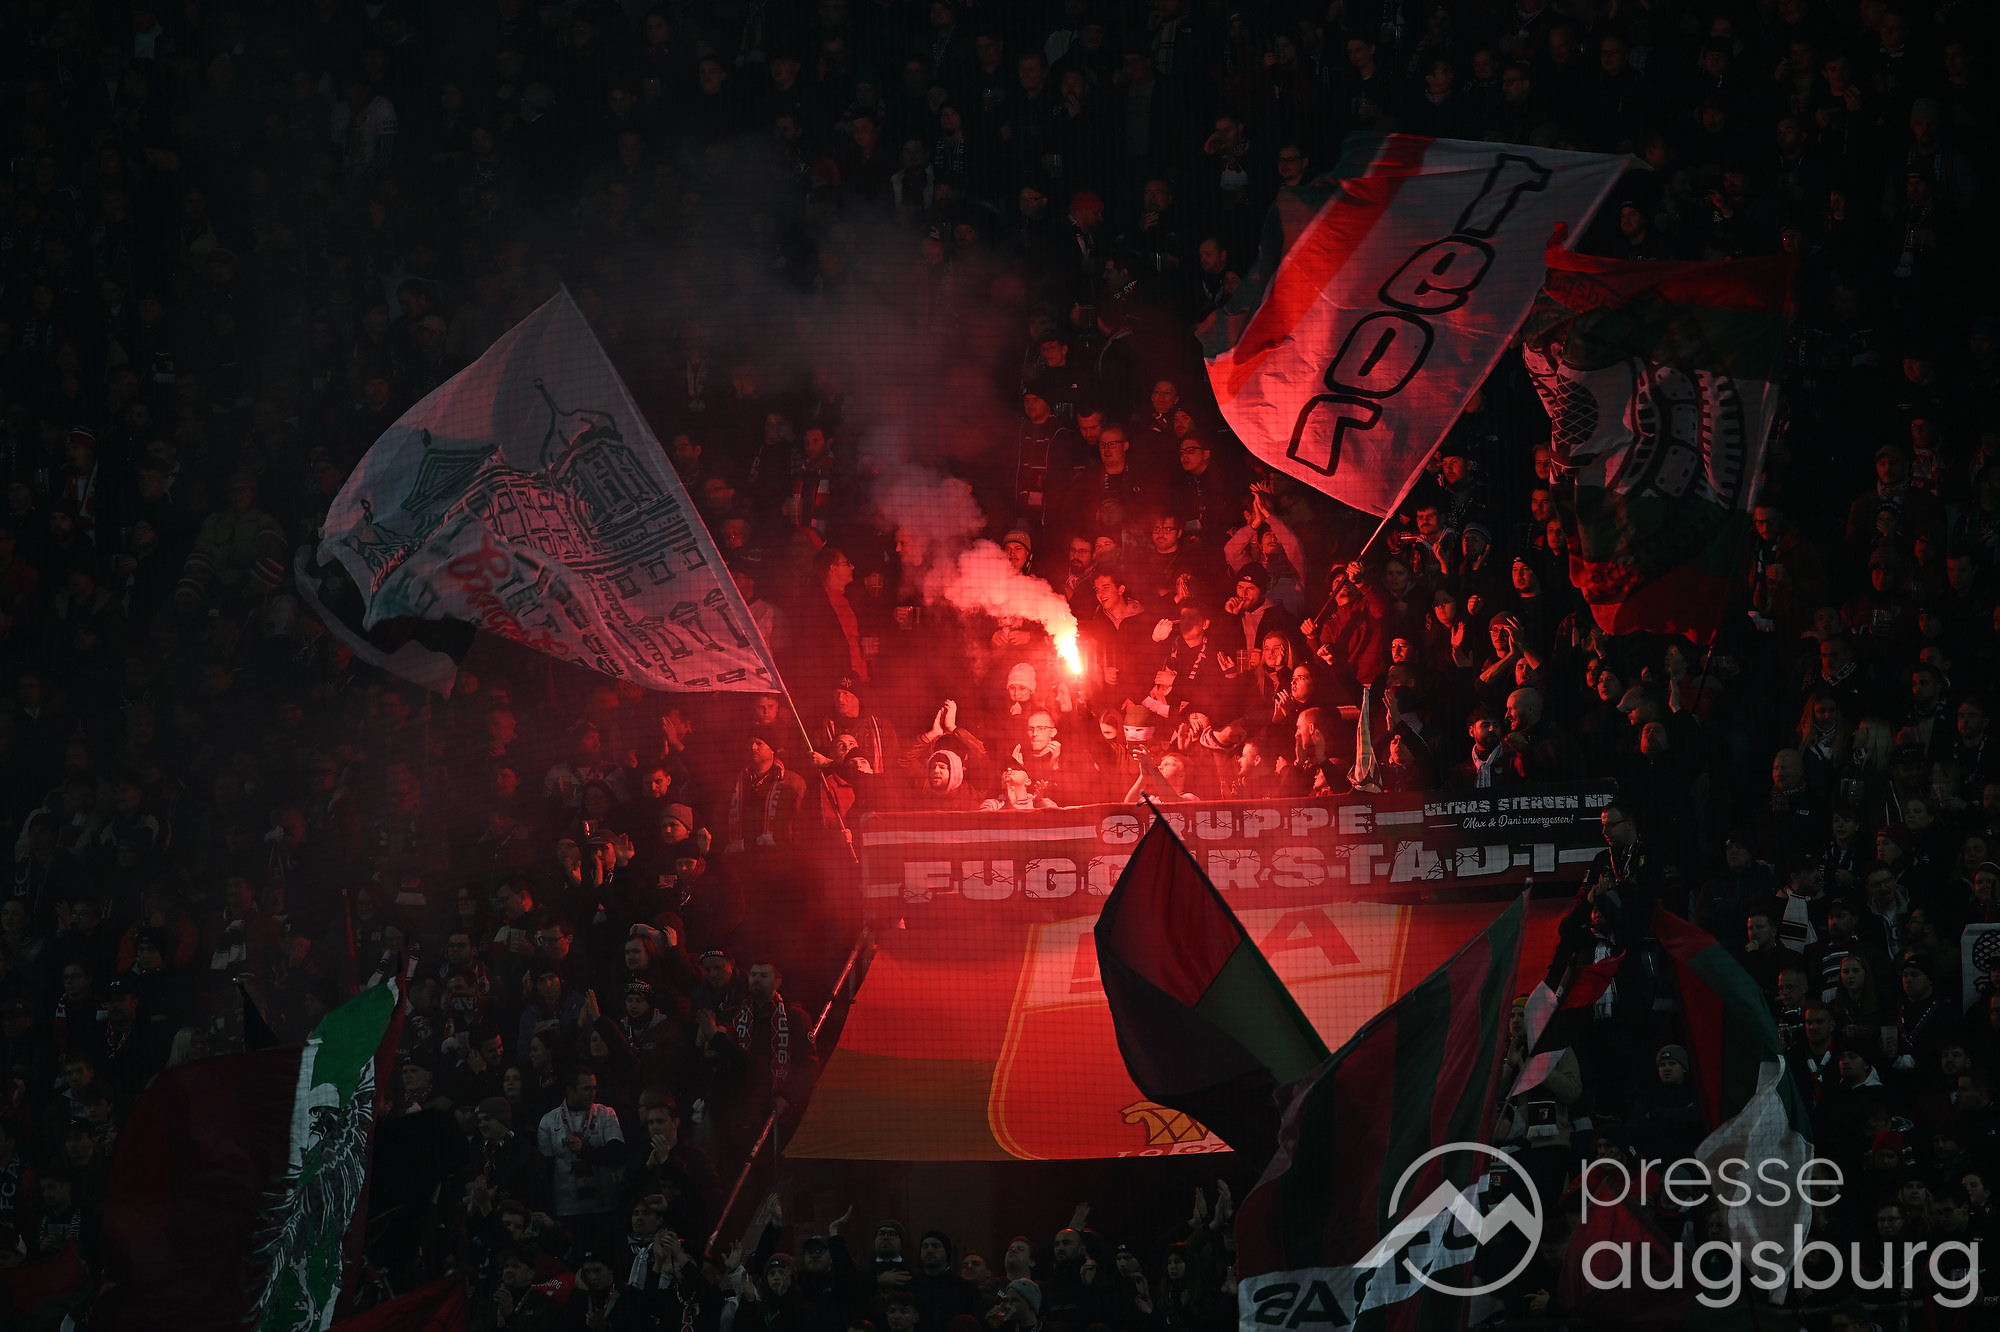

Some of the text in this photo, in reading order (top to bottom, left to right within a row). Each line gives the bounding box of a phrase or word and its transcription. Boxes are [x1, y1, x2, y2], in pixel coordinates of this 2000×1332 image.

[1424, 799, 1491, 817] ULTRAS
[1497, 795, 1579, 811] STERBEN
[1101, 804, 1373, 845] GRUPPE
[1462, 813, 1575, 830] Max & Dani unvergessen!
